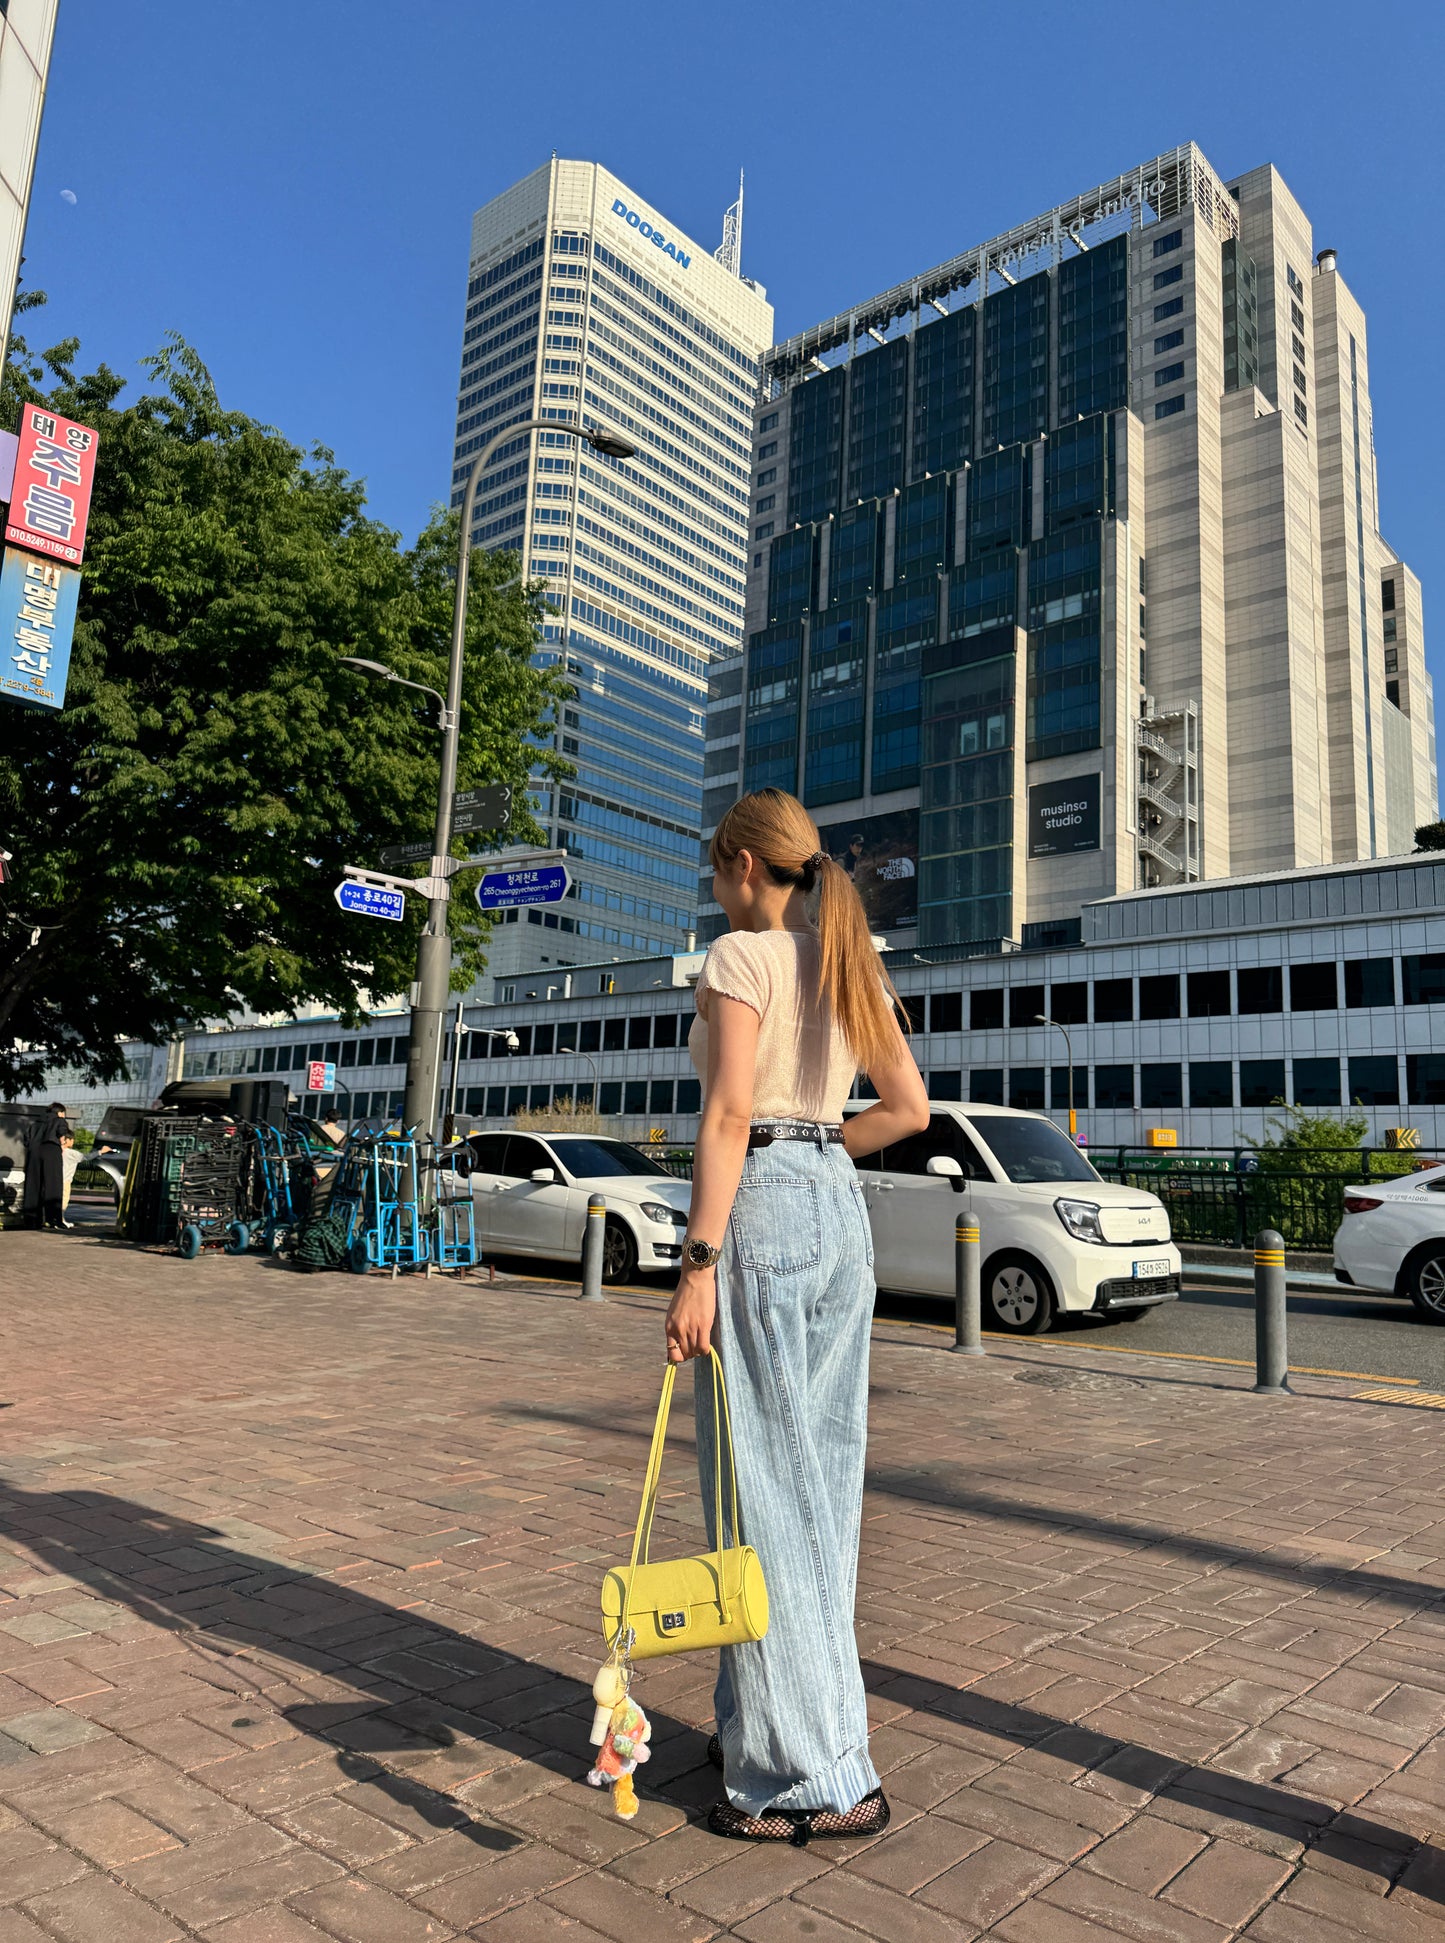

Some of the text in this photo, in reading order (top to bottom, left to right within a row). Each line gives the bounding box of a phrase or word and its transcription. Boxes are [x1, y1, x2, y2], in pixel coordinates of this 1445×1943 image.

[999, 180, 1166, 268] musinsa studio
[611, 199, 691, 269] DOOSAN
[31, 411, 91, 451] 태양
[23, 438, 81, 541] 주름
[10, 528, 64, 554] 010.5249.1159
[11, 562, 60, 678] 대명부동산
[1041, 802, 1087, 817] musinsa
[1045, 814, 1082, 829] studio
[877, 865, 902, 875] NORTH
[888, 858, 902, 866] THE
[507, 872, 539, 885] 청계천로
[884, 872, 902, 880] FACE
[484, 879, 561, 896] 265 Cheonggyecheon-ro 261
[363, 890, 401, 908] 종로40길
[350, 901, 400, 917] Jong-ro 40-gil
